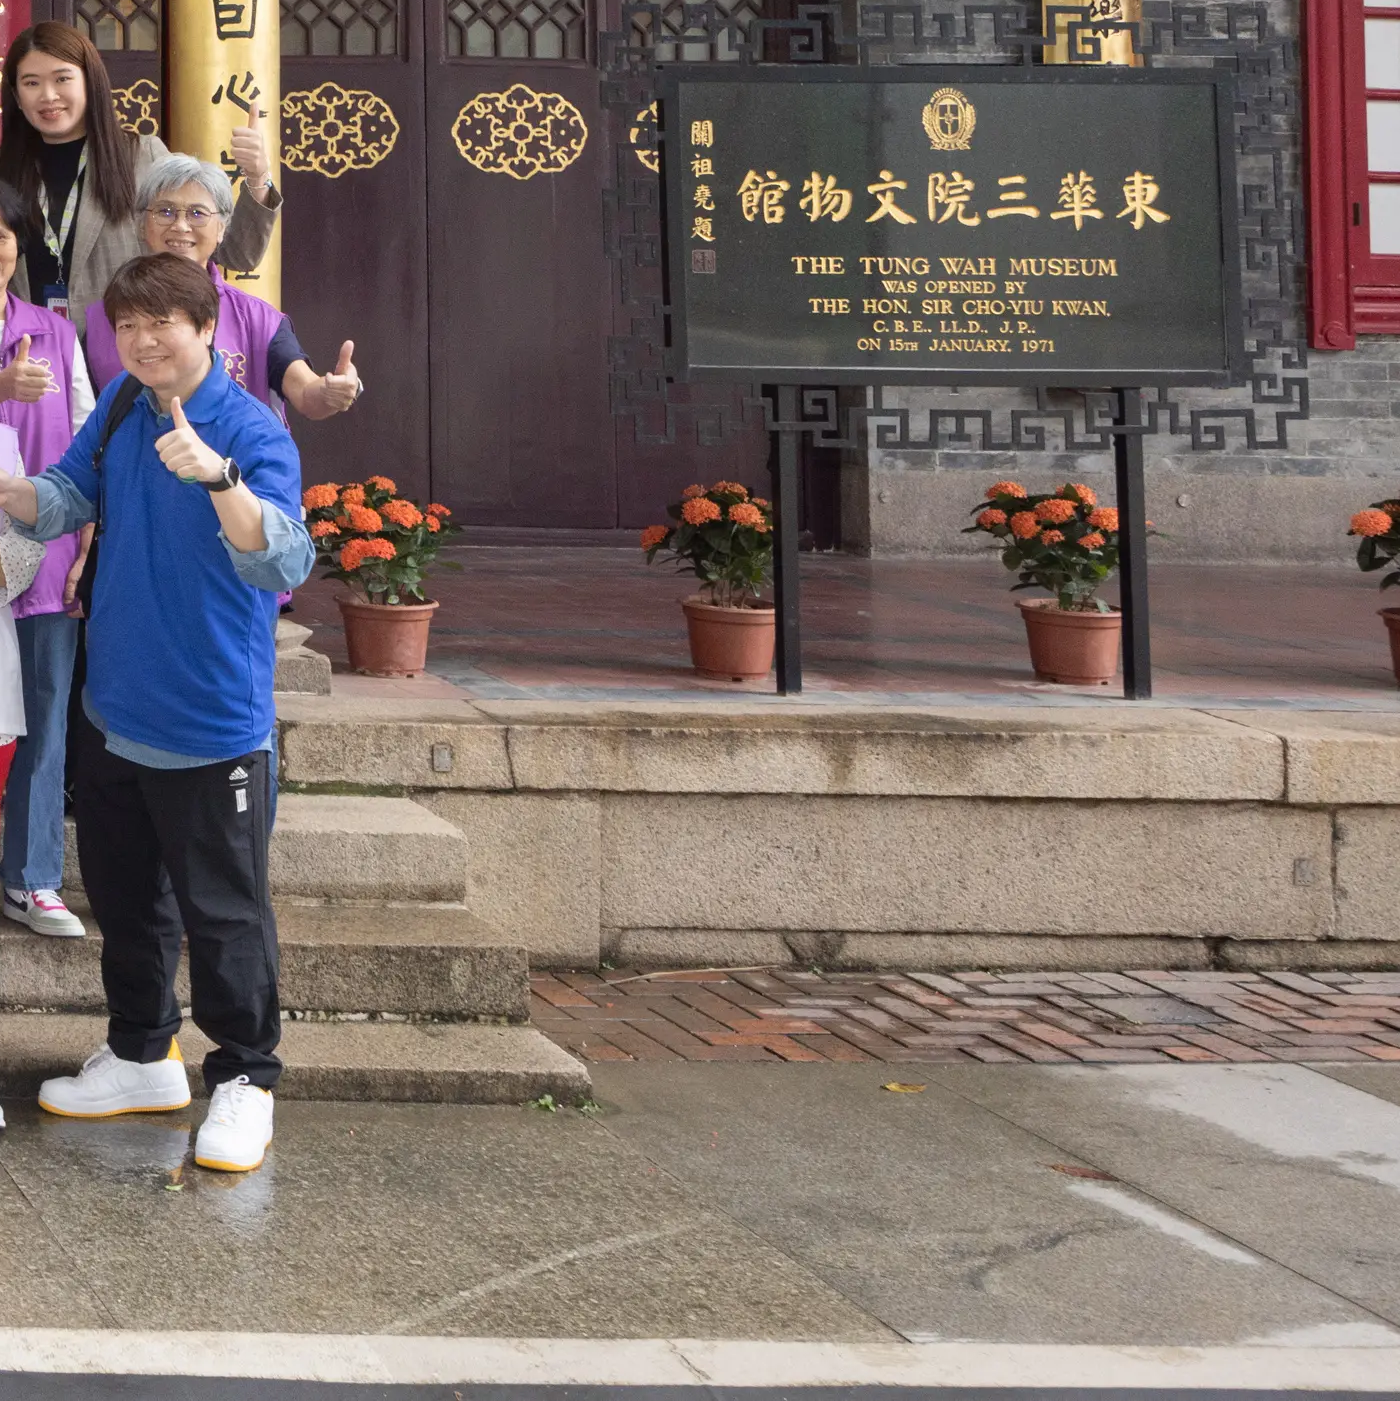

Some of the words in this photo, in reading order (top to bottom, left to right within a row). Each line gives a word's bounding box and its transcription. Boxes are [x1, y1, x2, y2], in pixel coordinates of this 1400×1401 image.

[737, 168, 1171, 232] 東華三院文物館
[791, 256, 846, 276] THE
[859, 256, 932, 277] TUNG
[939, 257, 998, 276] WAH
[1009, 257, 1119, 277] MUSEUM
[881, 279, 918, 294] WAS
[925, 279, 997, 295] OPENED
[1004, 280, 1028, 295] BY
[808, 297, 850, 315] THE
[862, 298, 913, 315] HON.
[921, 299, 955, 315] SIR
[961, 299, 1045, 316] CHO-YIU
[856, 337, 881, 352] ON
[1021, 338, 1056, 354] 1971
